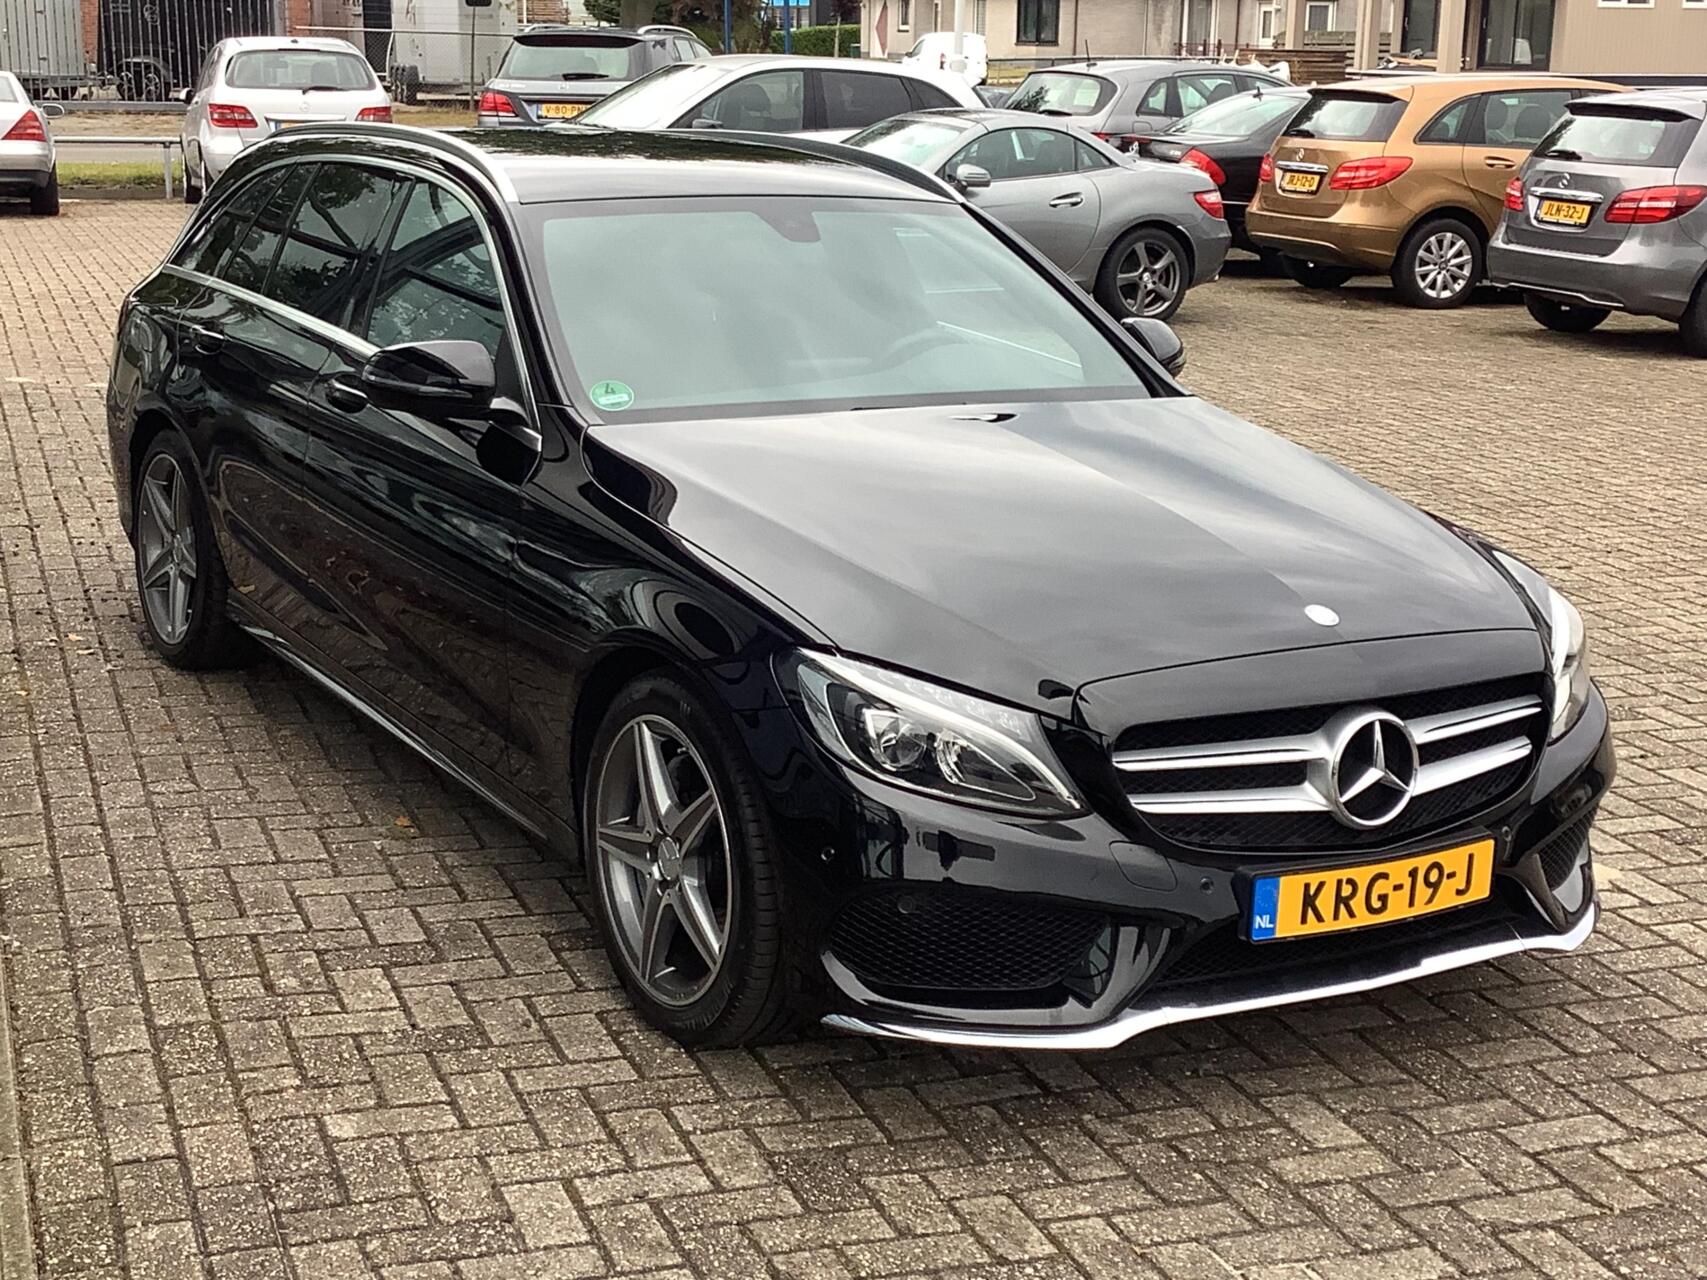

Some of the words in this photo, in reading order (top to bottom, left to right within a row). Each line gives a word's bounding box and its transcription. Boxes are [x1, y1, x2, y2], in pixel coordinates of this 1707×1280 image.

[1544, 201, 1586, 220] JLN-32-J
[605, 383, 616, 395] 4
[1300, 853, 1475, 925] KRG-19-J
[1255, 914, 1274, 929] NL
